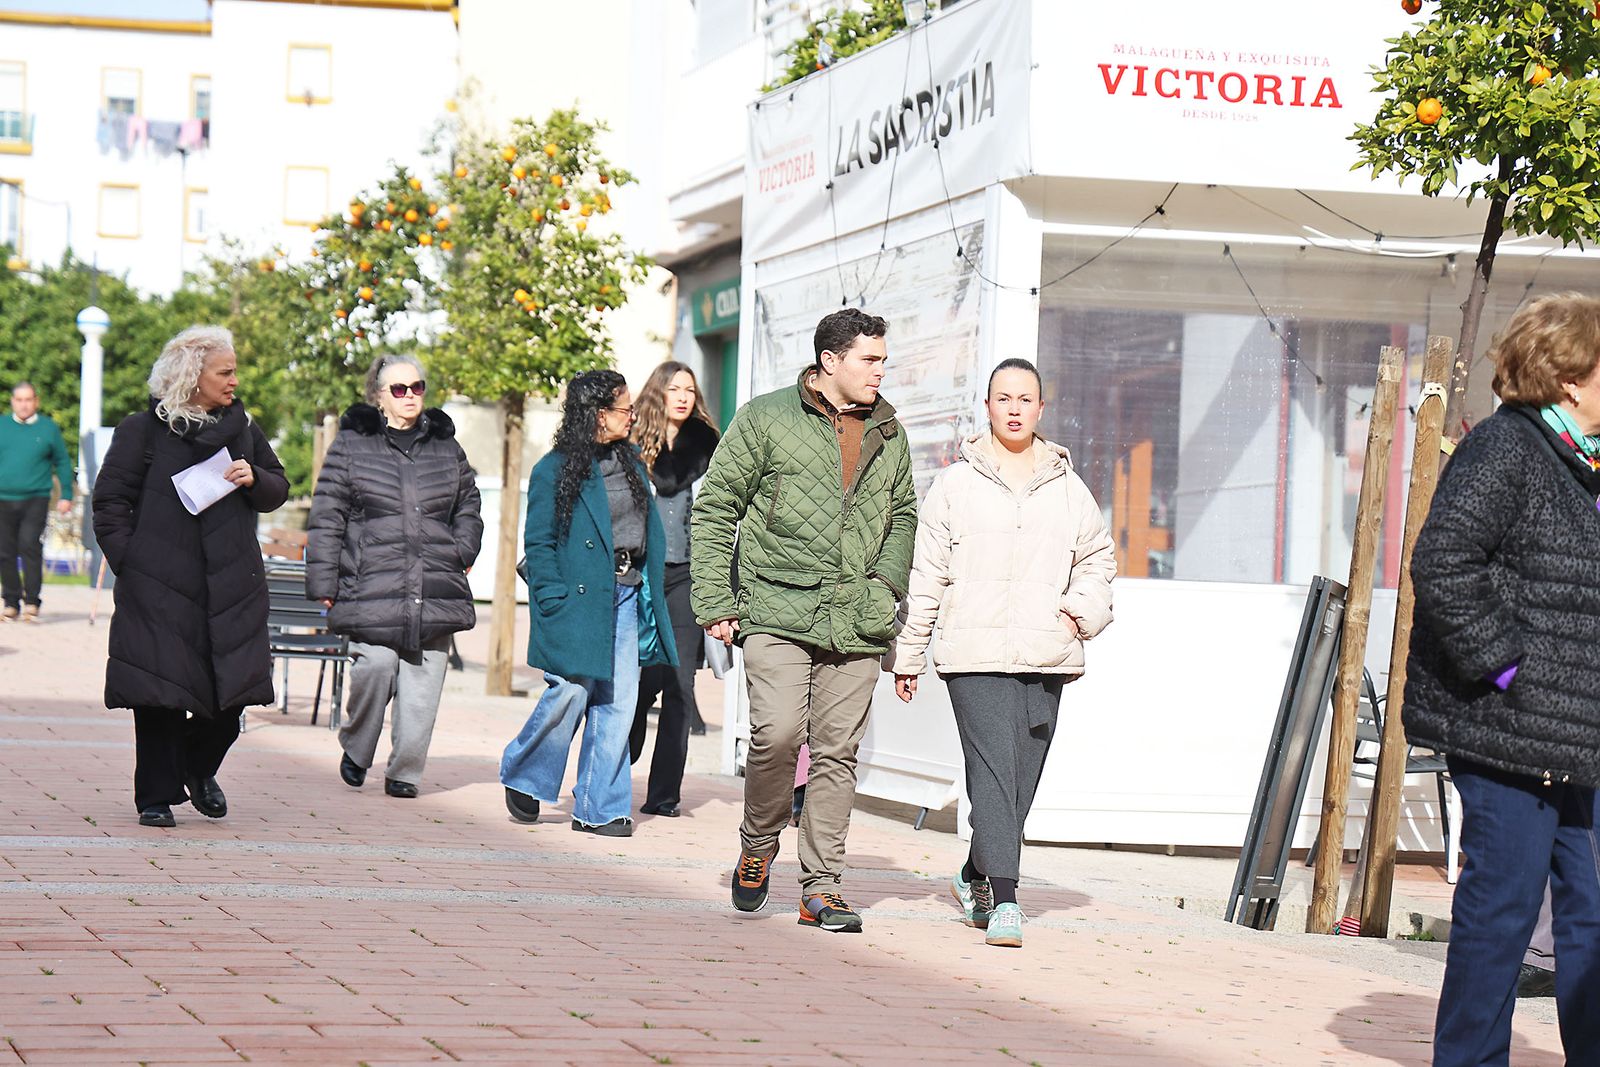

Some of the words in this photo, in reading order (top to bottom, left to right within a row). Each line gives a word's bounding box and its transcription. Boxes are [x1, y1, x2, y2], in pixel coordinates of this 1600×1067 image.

[1113, 43, 1216, 61] MALAGUEÑA
[1223, 51, 1234, 62] Y
[1238, 52, 1331, 67] EXQUISITA
[1097, 63, 1343, 109] VICTORIA
[834, 118, 864, 177] LA
[868, 49, 994, 165] SACRISTÍA
[1182, 108, 1227, 120] DESDE
[1232, 111, 1260, 122] 1928
[758, 151, 816, 193] VICTORIA
